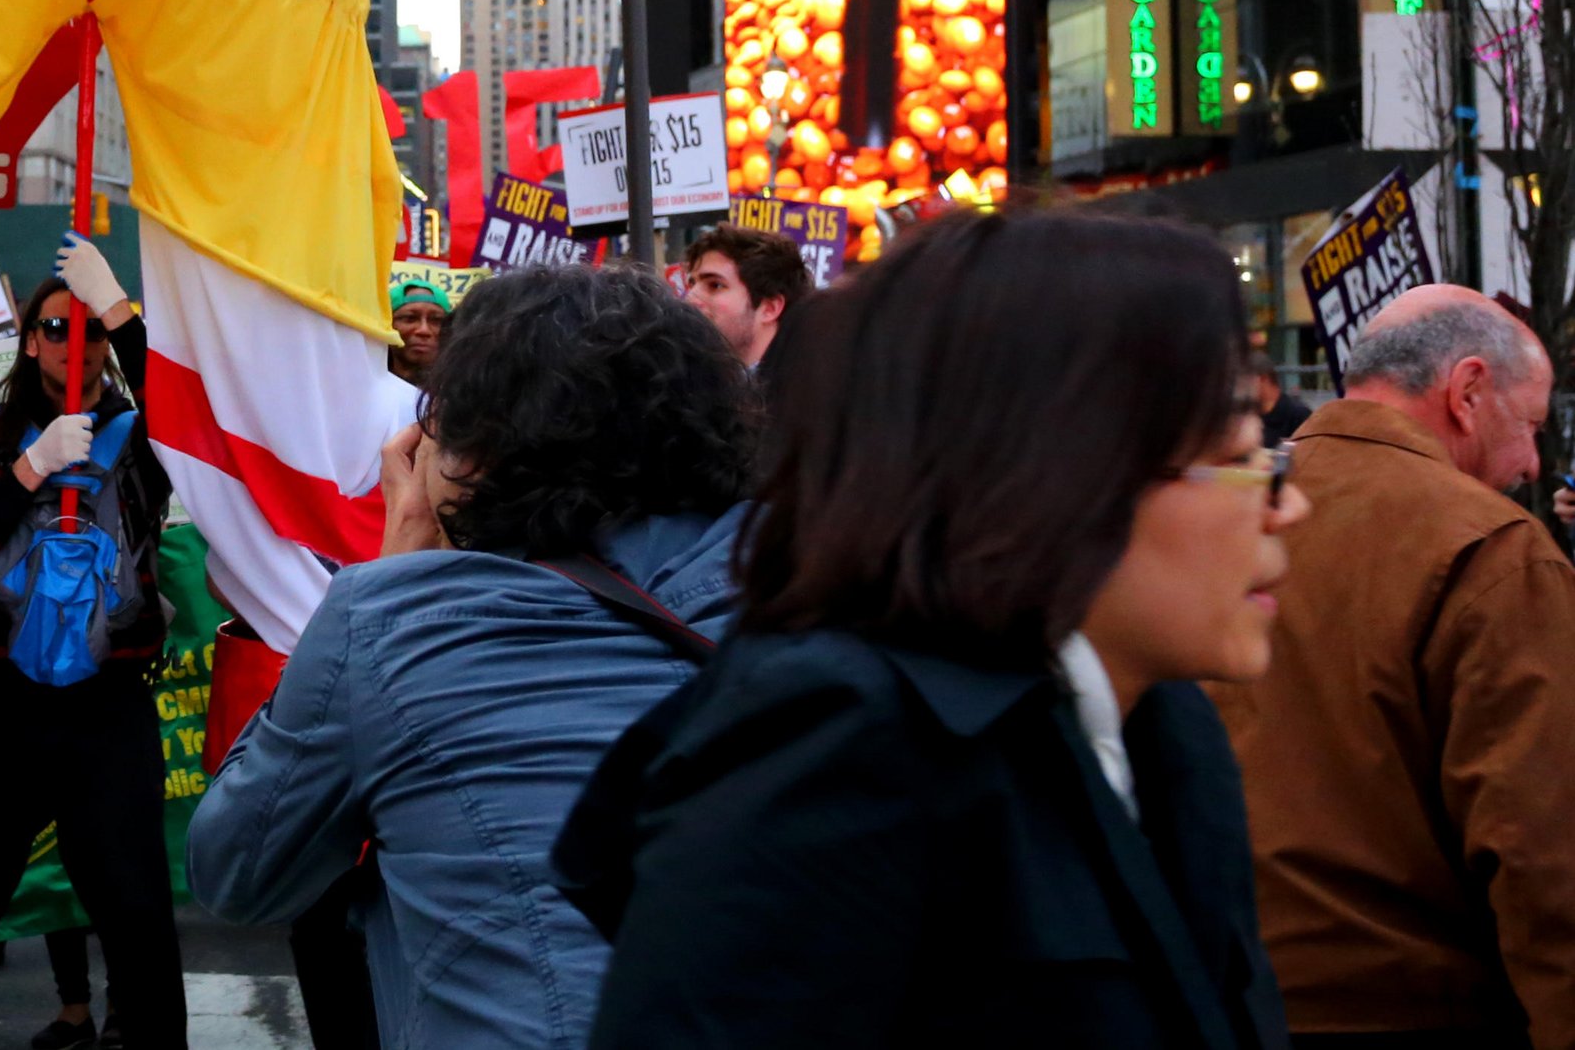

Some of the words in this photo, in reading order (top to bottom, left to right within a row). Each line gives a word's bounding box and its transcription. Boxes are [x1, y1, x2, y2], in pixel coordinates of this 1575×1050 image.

[580, 126, 625, 166] FIGHT
[666, 112, 702, 153] $15
[496, 178, 554, 223] FIGHT
[729, 198, 784, 233] FIGHT
[806, 206, 839, 241] $15
[507, 222, 587, 268] RAISE
[1308, 222, 1364, 291] FIGHT
[1343, 217, 1418, 315] RAISE
